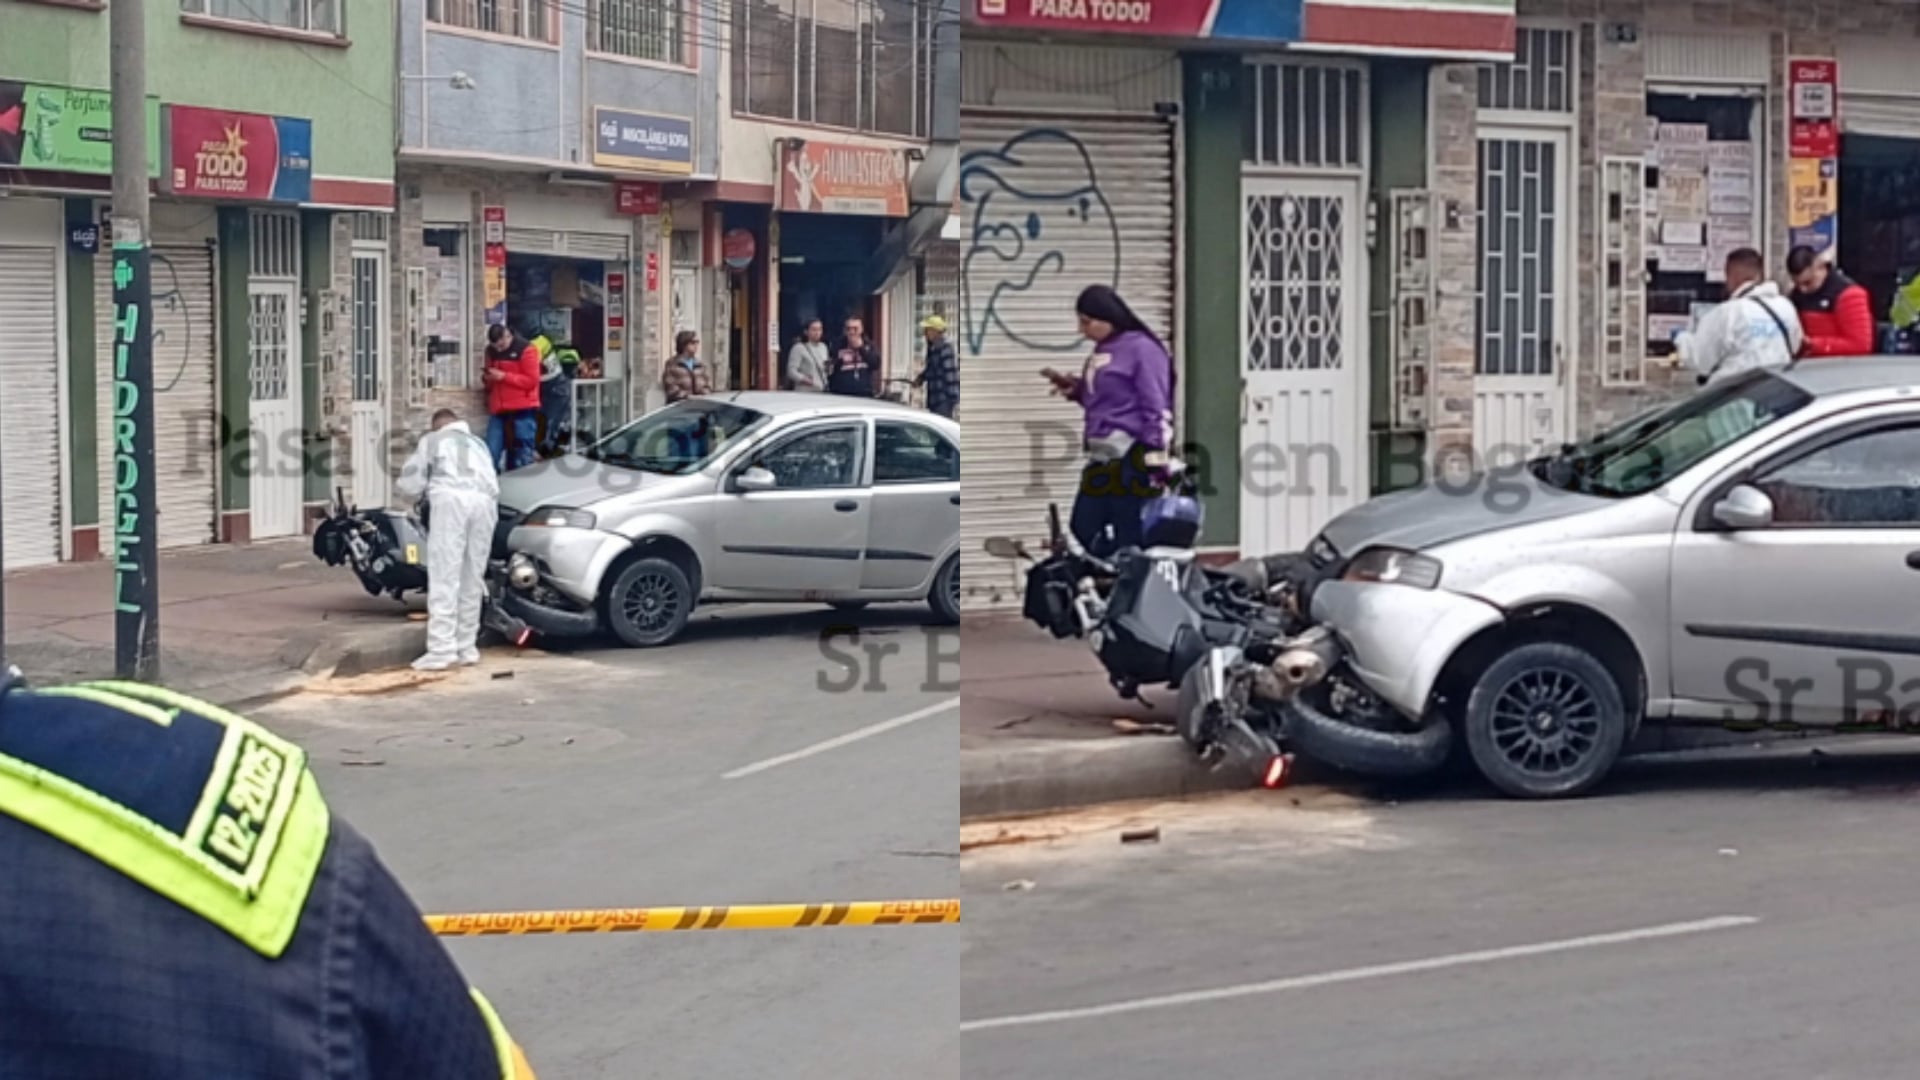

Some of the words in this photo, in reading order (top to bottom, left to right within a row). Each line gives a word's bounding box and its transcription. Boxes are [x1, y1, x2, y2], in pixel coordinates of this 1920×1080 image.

[195, 152, 248, 177] TODO
[73, 228, 97, 247] tigo
[113, 303, 141, 613] HIDROGEL
[443, 910, 543, 931] PELIGRO
[551, 908, 583, 926] NO
[591, 905, 649, 924] PASE
